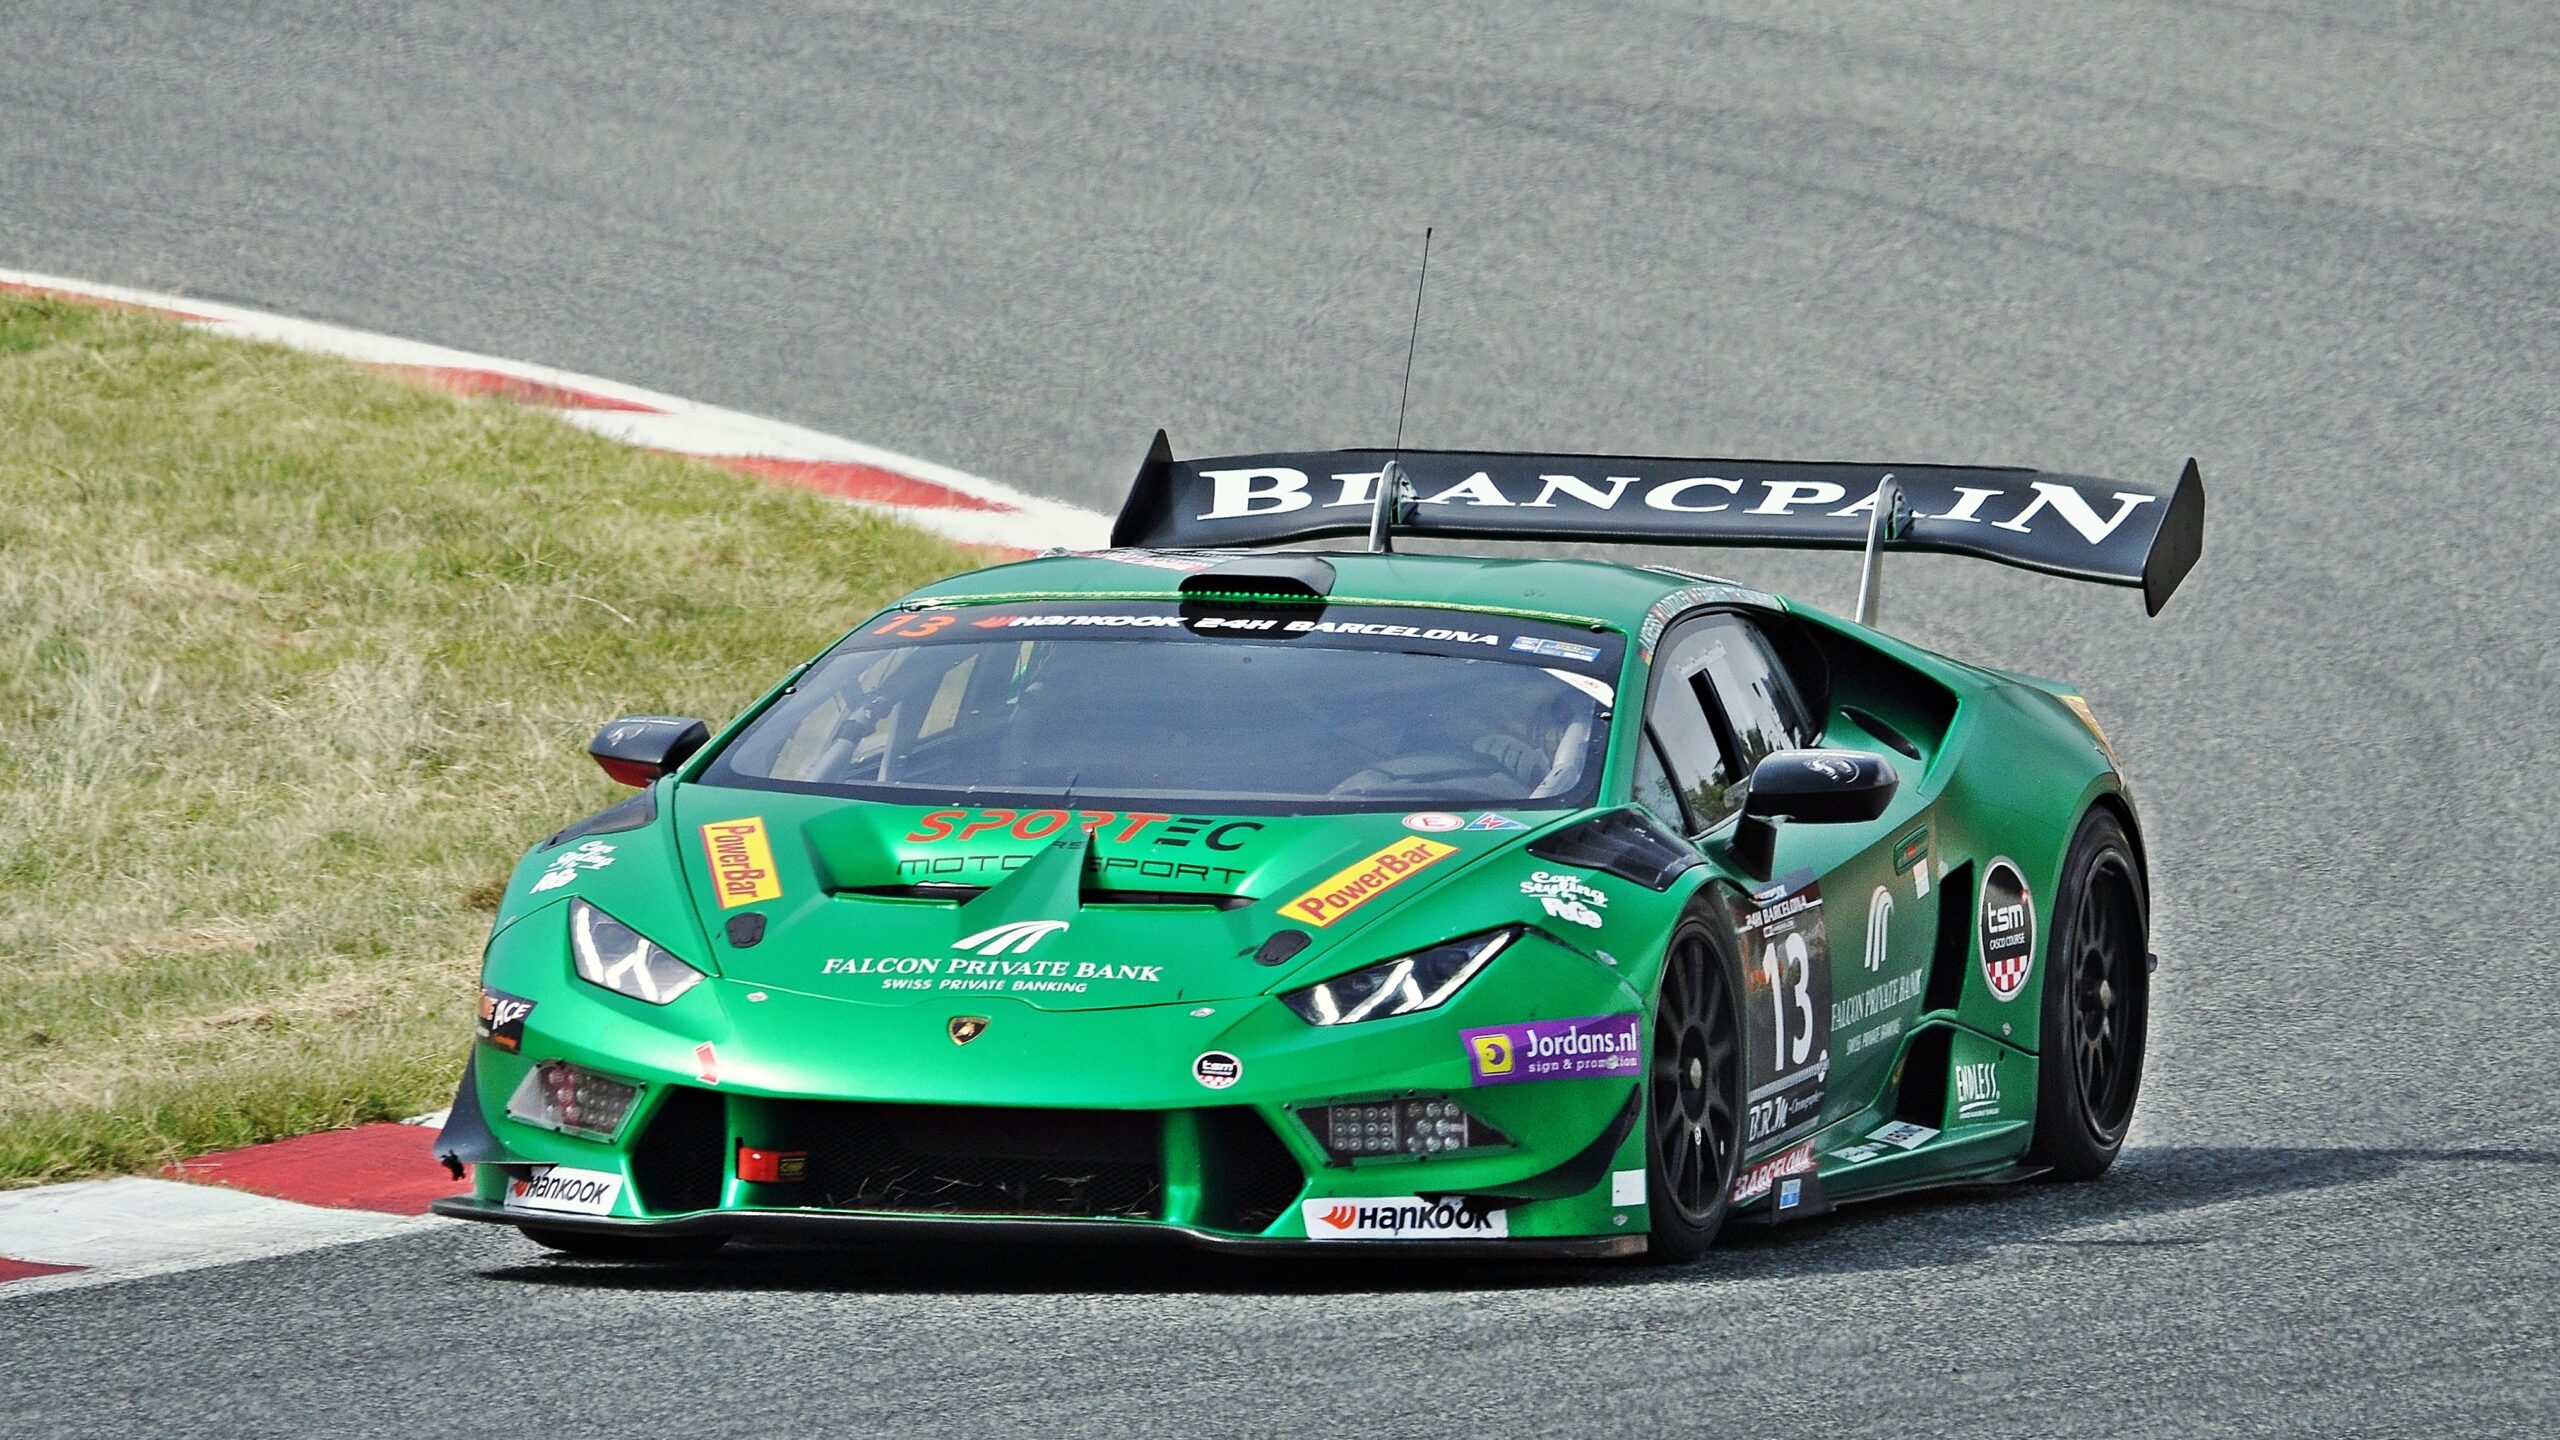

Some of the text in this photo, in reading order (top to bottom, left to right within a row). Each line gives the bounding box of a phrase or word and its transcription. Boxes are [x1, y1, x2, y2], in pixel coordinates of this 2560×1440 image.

[872, 614, 955, 638] 13
[1194, 616, 1279, 631] 24H
[1283, 619, 1499, 646] BARCELONA
[904, 809, 1264, 852] SPORTEC
[711, 825, 766, 898] PowerBar
[1297, 841, 1434, 921] PowerBar
[1987, 902, 2025, 934] tsm
[821, 957, 1165, 983] FALCON PRIVATE BANK
[881, 978, 1088, 993] SWISS PRIVATE BANKING
[1762, 932, 1813, 1072] 13
[1526, 1023, 1637, 1058] Jordans.nl
[1528, 1056, 1638, 1074] sign & promion
